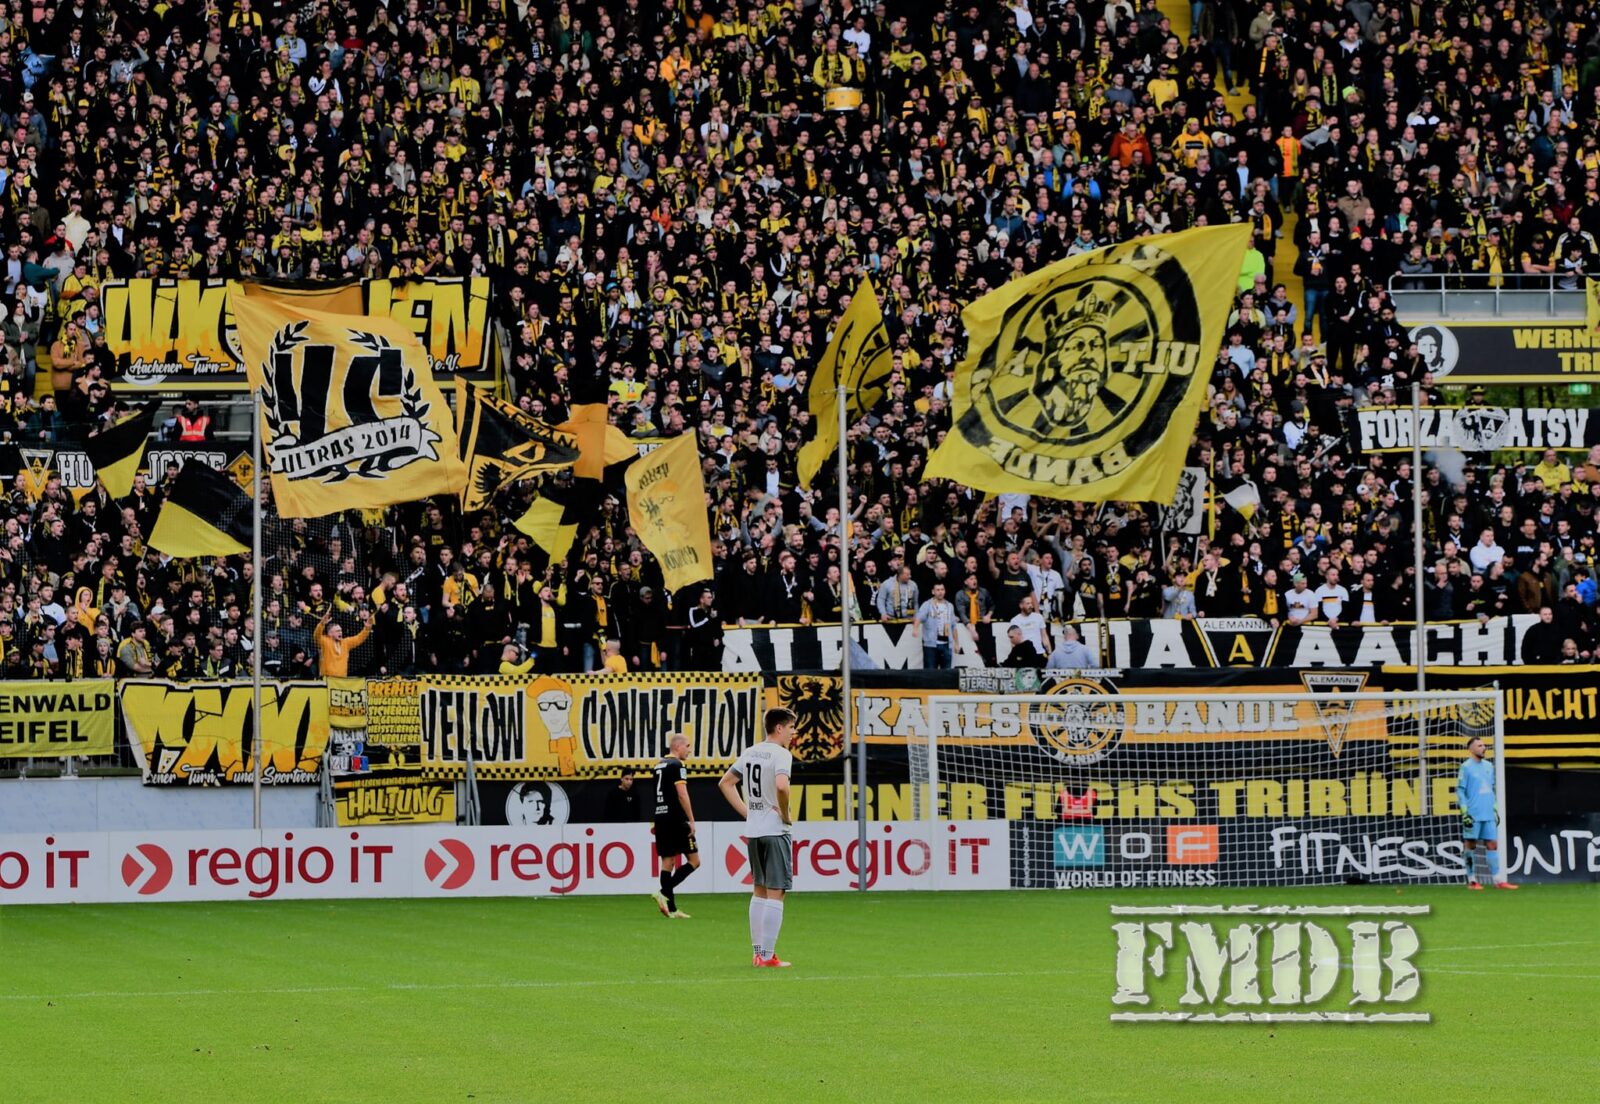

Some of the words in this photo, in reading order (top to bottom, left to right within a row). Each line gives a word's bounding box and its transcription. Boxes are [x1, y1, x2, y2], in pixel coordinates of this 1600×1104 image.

[1358, 409, 1455, 450] FORZA
[1504, 408, 1589, 448] ATSV
[281, 437, 355, 474] ULTRAS
[1228, 634, 1254, 662] A
[421, 689, 524, 761] YELLOW
[582, 687, 758, 759] CONNECTION
[856, 697, 1021, 737] KARLS
[1134, 700, 1299, 733] BANDE
[746, 763, 761, 798] 19
[1209, 771, 1462, 816] TRIBÜNE
[347, 786, 443, 819] HALTUNG
[45, 836, 90, 889] iT
[188, 832, 334, 898] regio
[350, 832, 393, 883] iT
[491, 827, 635, 894] regio
[792, 824, 931, 890] regio
[1269, 827, 1467, 876] FITNESS
[1055, 871, 1115, 889] WORLD
[1120, 871, 1142, 887] OF
[1147, 869, 1216, 886] FITNESS
